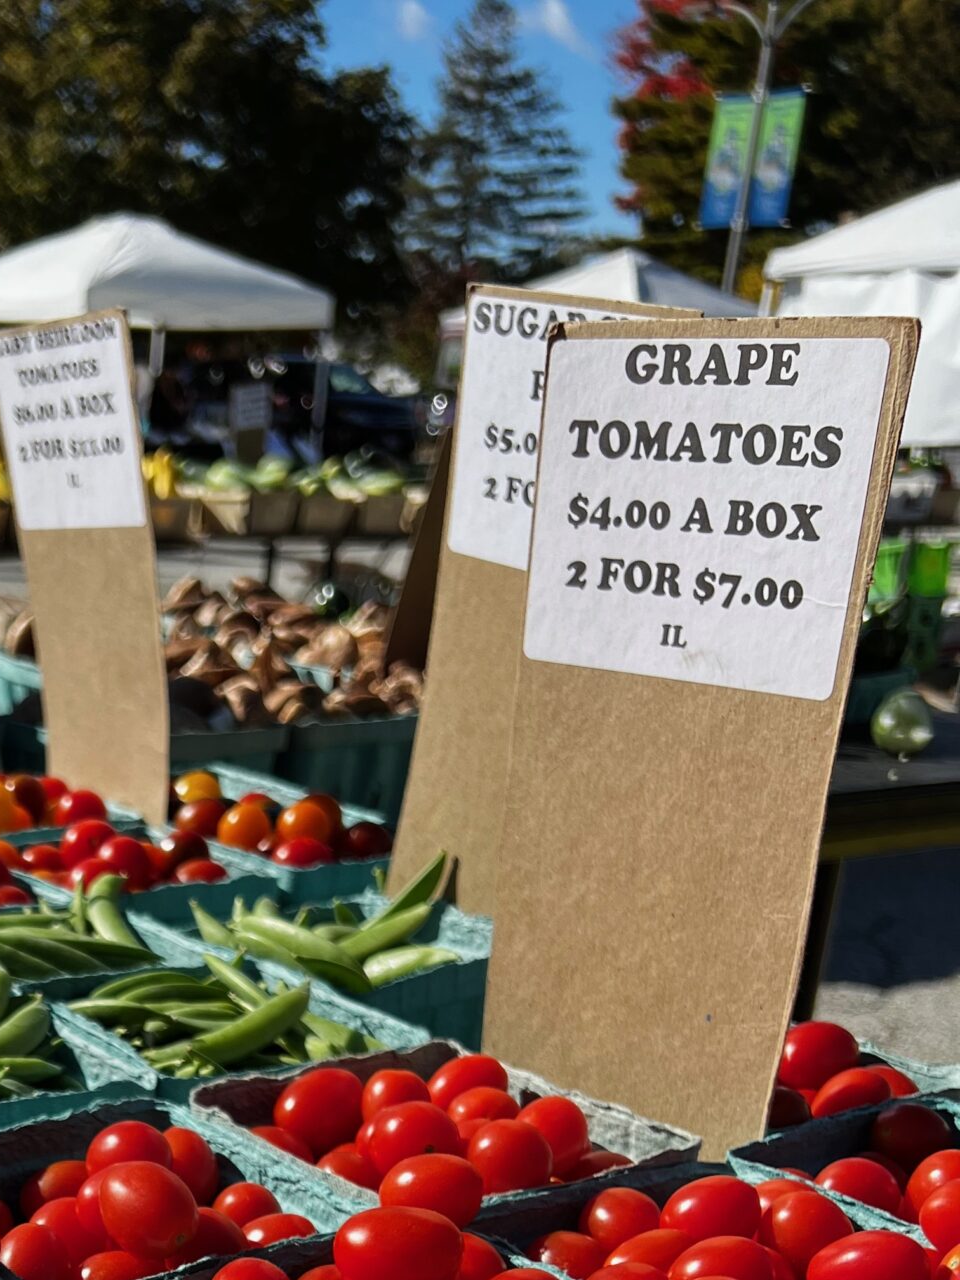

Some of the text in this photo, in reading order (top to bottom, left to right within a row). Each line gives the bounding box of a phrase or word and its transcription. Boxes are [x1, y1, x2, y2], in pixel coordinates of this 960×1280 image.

[16, 359, 101, 387] TOMATOES
[624, 342, 801, 387] GRAPE
[60, 395, 75, 420] A
[76, 391, 118, 417] BOX
[17, 443, 28, 463] 2
[29, 437, 66, 462] FOR
[568, 419, 844, 469] TOMATOES
[483, 477, 497, 500] 2
[567, 492, 823, 542] $4.00 A BOX
[565, 557, 804, 610] 2 FOR $7.00
[660, 623, 688, 649] IL
